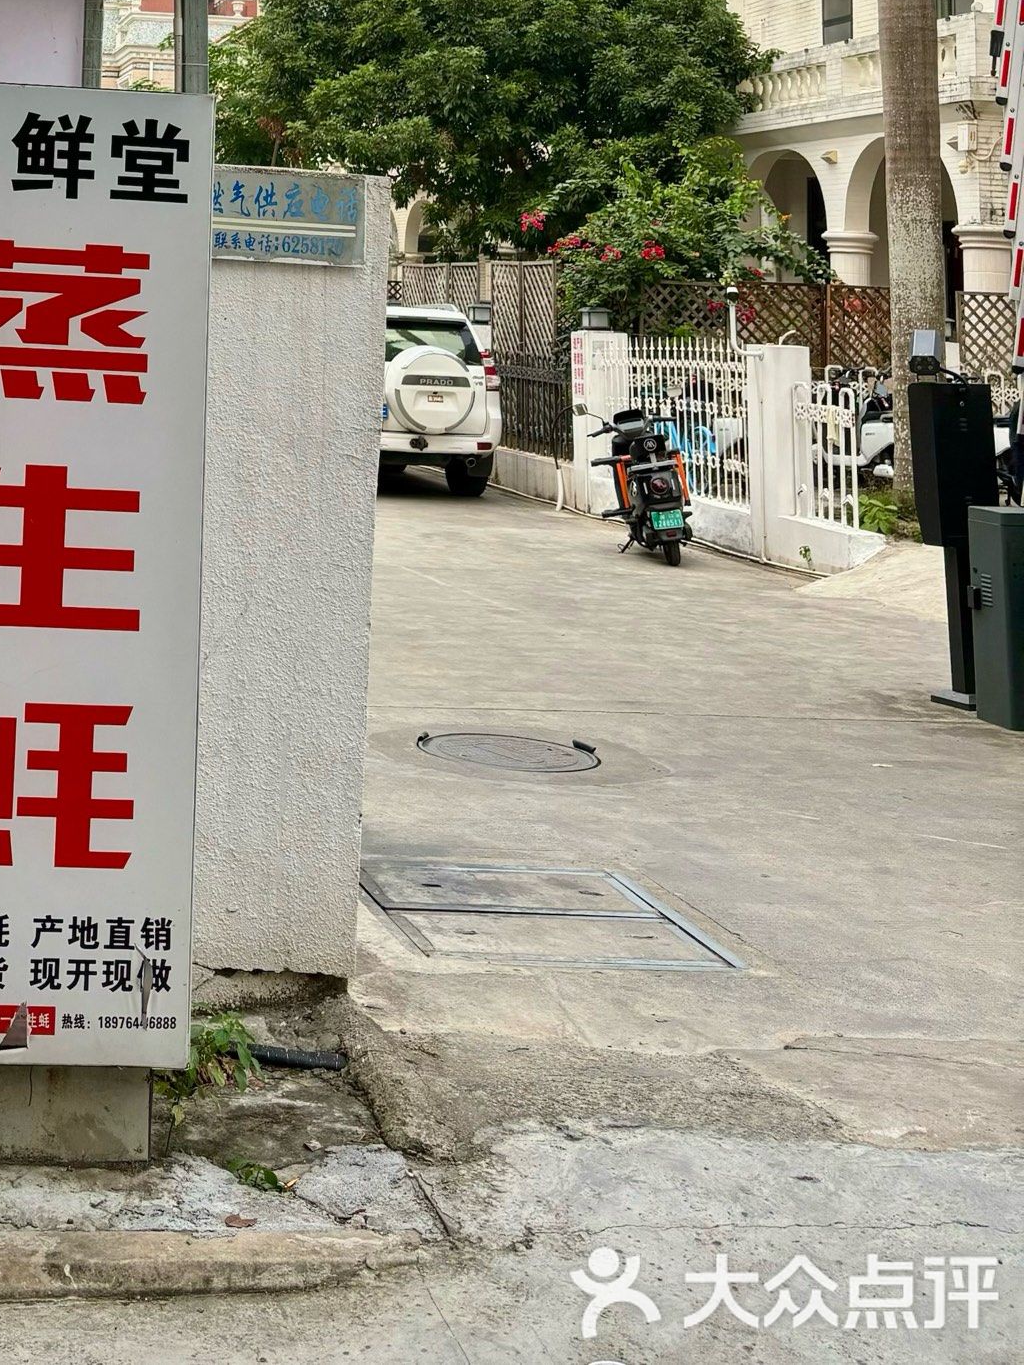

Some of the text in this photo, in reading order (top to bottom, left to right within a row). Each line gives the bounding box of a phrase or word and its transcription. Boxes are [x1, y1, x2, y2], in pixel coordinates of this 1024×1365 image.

[419, 378, 454, 386] PRADO
[30, 915, 173, 951] 产地直销
[29, 957, 172, 993] 现开现做
